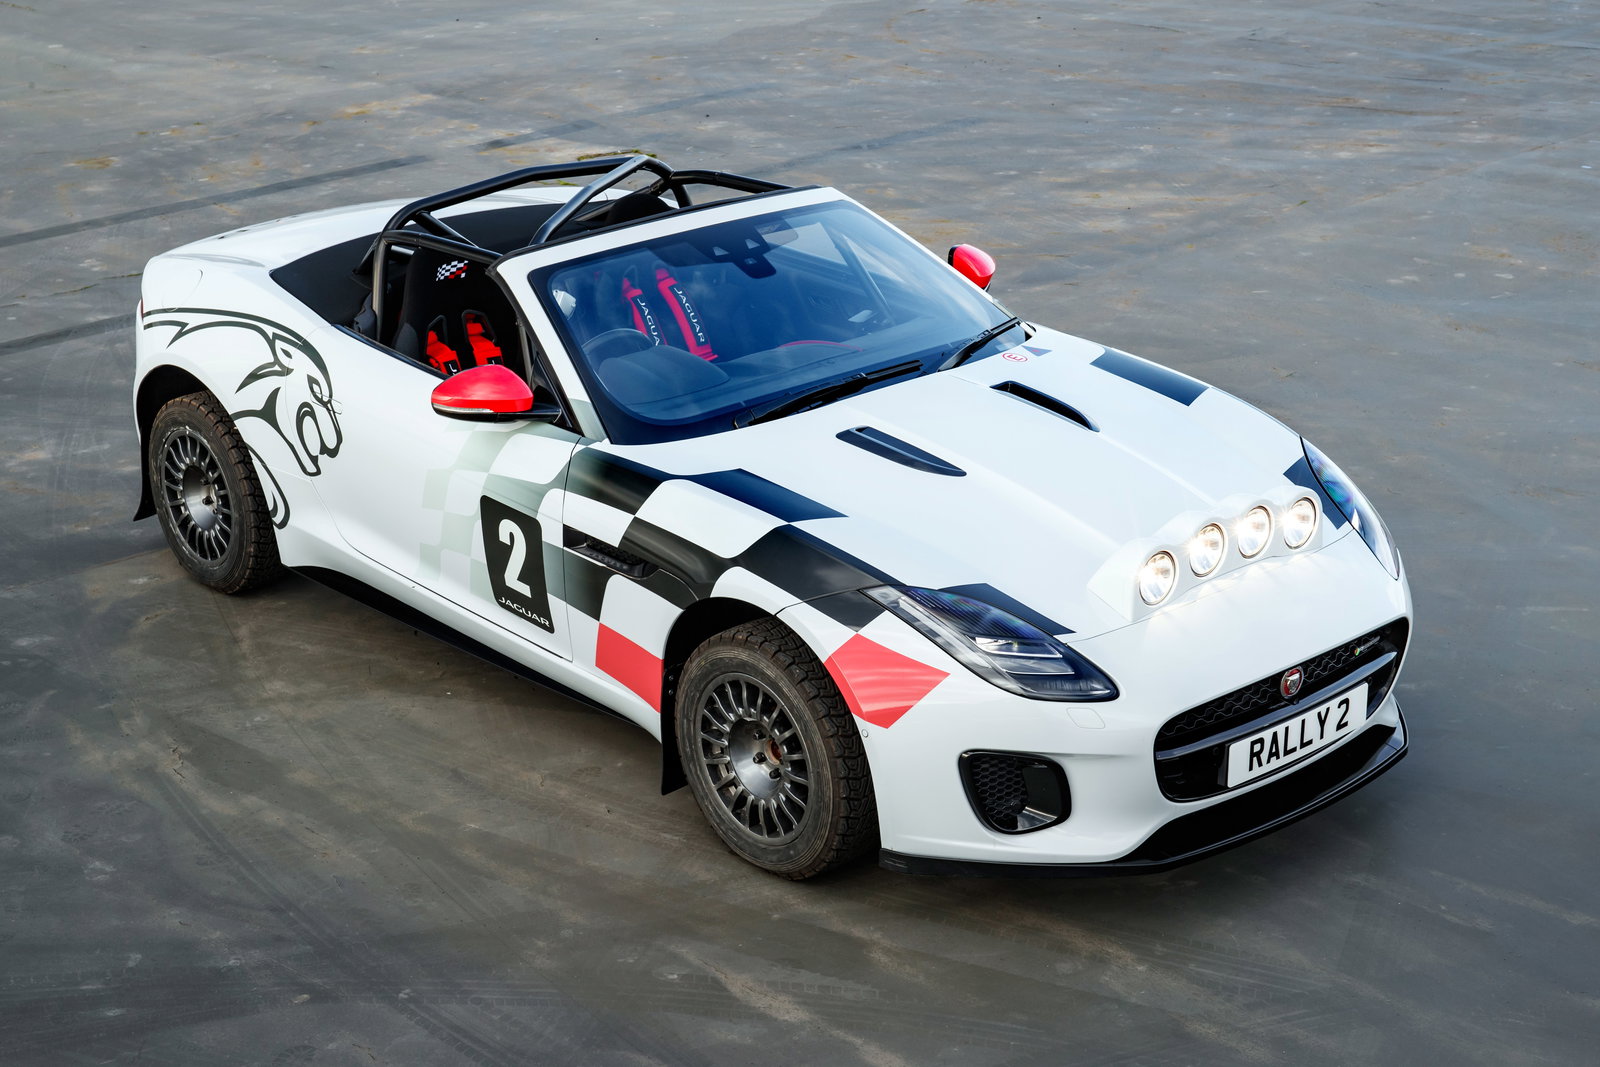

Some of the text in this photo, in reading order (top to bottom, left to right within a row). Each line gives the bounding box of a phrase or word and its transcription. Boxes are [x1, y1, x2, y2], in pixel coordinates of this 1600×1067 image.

[637, 298, 660, 346] JAGUA
[673, 287, 705, 342] JAGUAR
[498, 518, 532, 599] 2
[498, 596, 551, 628] JAGUAR
[1248, 697, 1350, 772] RALLY 2
